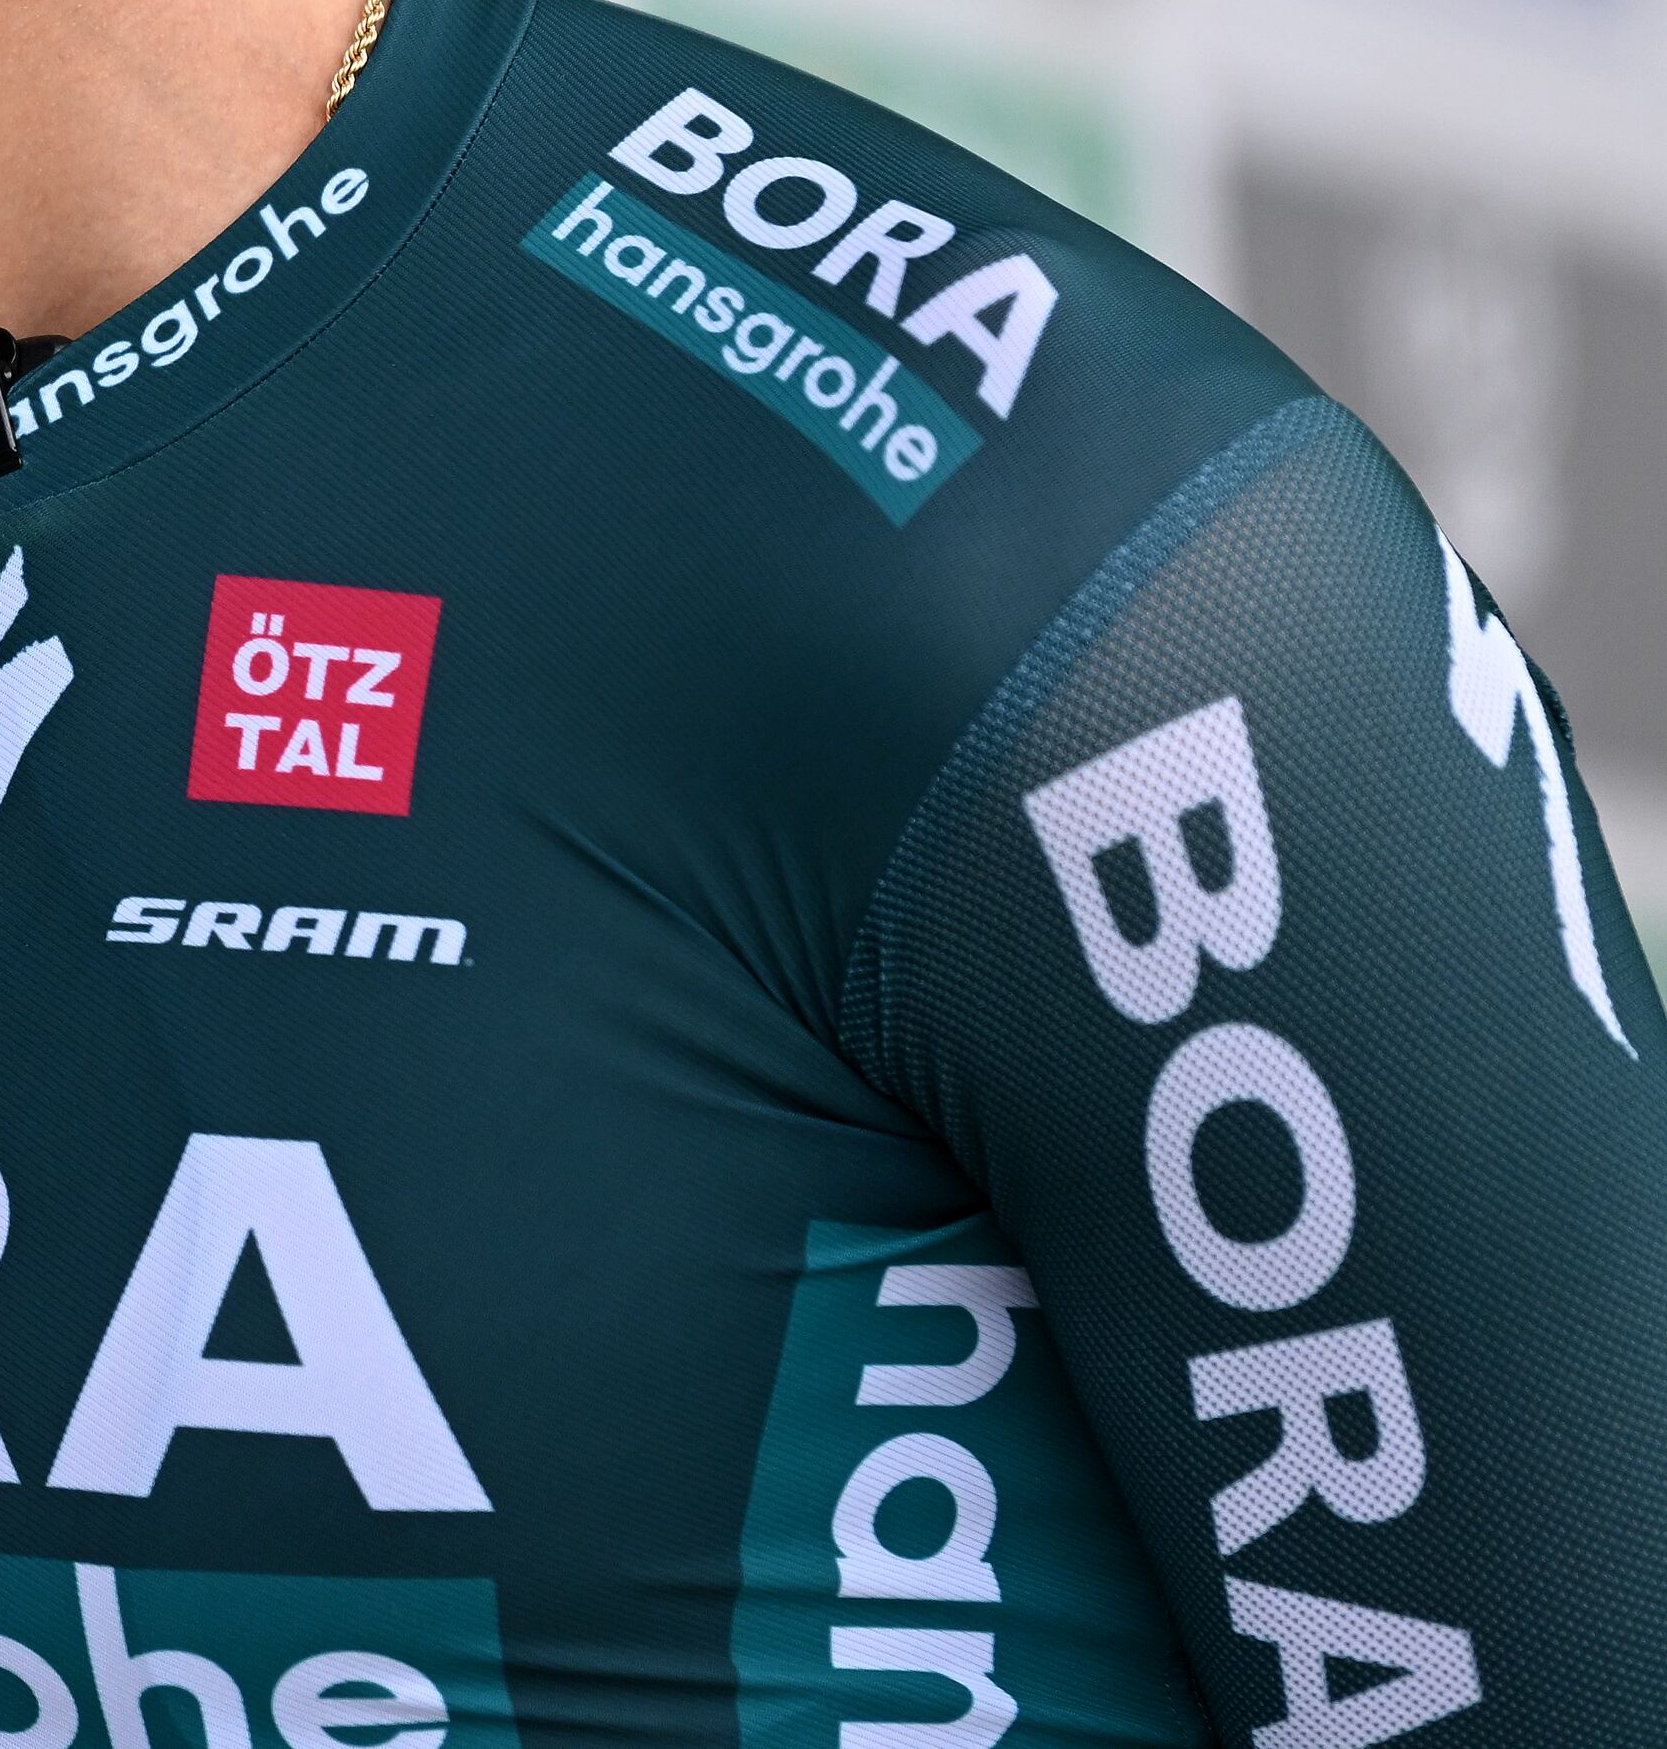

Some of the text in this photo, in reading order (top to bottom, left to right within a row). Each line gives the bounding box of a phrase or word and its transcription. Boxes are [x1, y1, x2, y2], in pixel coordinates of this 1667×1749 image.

[550, 180, 938, 482] hansgrohe
[607, 86, 1059, 421] BORA
[225, 712, 384, 782] TAL
[232, 611, 402, 708] ÖTZ
[105, 895, 468, 966] SRAM
[1024, 695, 1483, 1749] BORA
